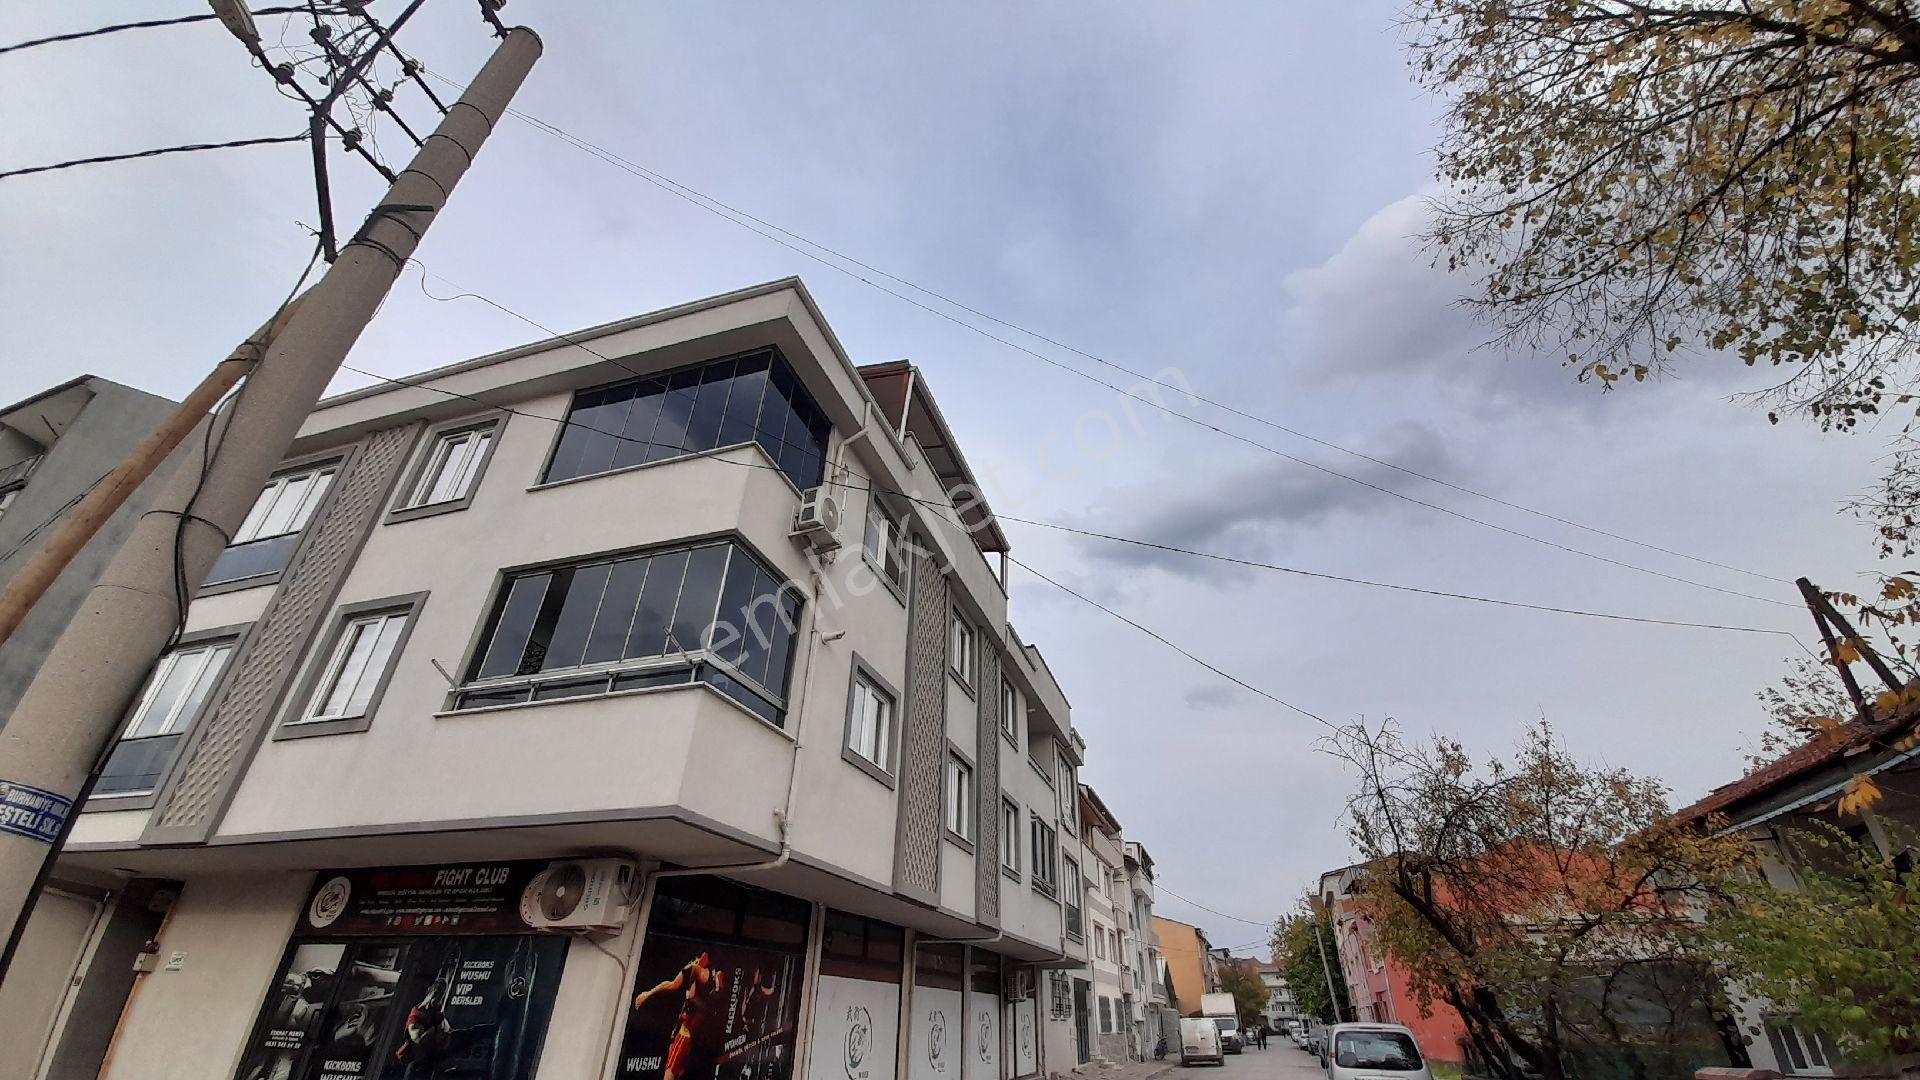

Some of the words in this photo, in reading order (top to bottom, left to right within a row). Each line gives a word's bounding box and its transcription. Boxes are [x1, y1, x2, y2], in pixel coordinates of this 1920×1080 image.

[434, 868, 473, 886] FIGHT
[475, 867, 510, 885] CLUB
[460, 970, 491, 980] WUSHU
[456, 983, 473, 995] VIP
[726, 967, 742, 1034] KICKBOKS
[323, 1060, 362, 1072] KICKBOKS
[626, 1056, 662, 1072] WUSHU
